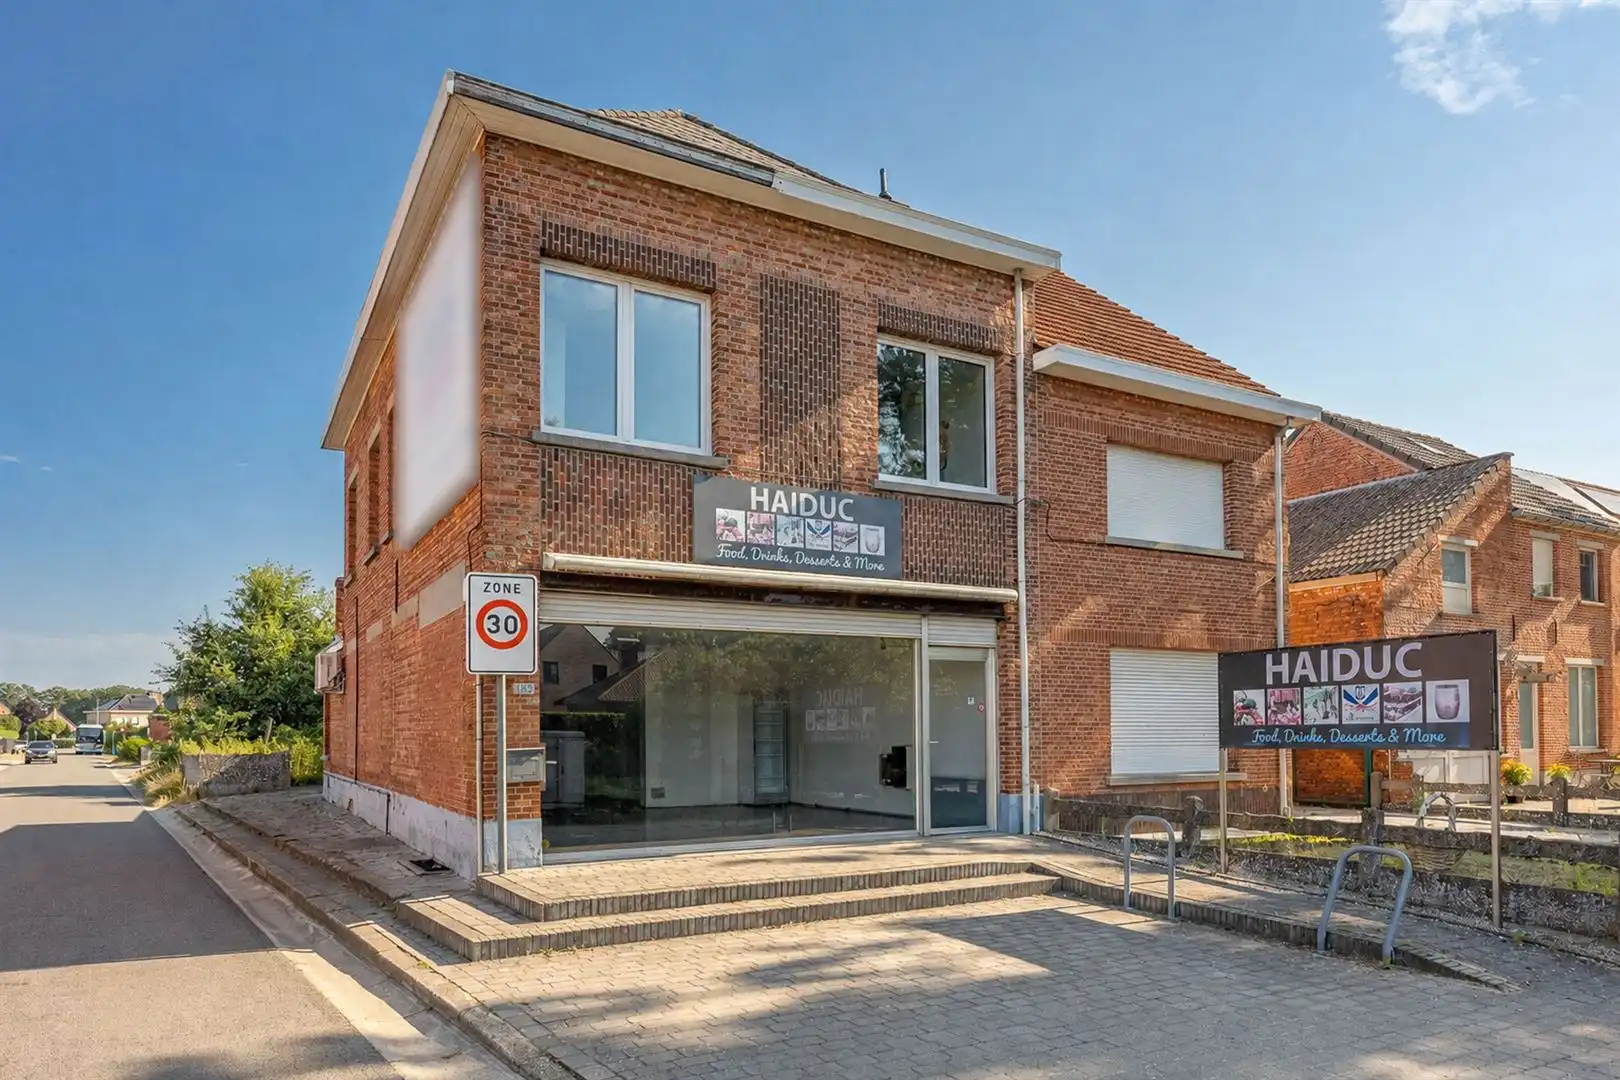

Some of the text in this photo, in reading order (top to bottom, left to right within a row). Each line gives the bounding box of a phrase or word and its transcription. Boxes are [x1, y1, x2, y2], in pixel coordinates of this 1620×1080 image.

[751, 486, 856, 522] HAIDUC
[716, 543, 885, 572] Food, Drinks, Desserts & More
[483, 582, 521, 594] ZONE
[486, 614, 518, 635] 30
[1265, 642, 1423, 685] HAIDUC
[1252, 728, 1282, 744] Food,
[1329, 727, 1386, 743] Desserts
[1387, 728, 1400, 743] &
[1402, 728, 1446, 743] More
